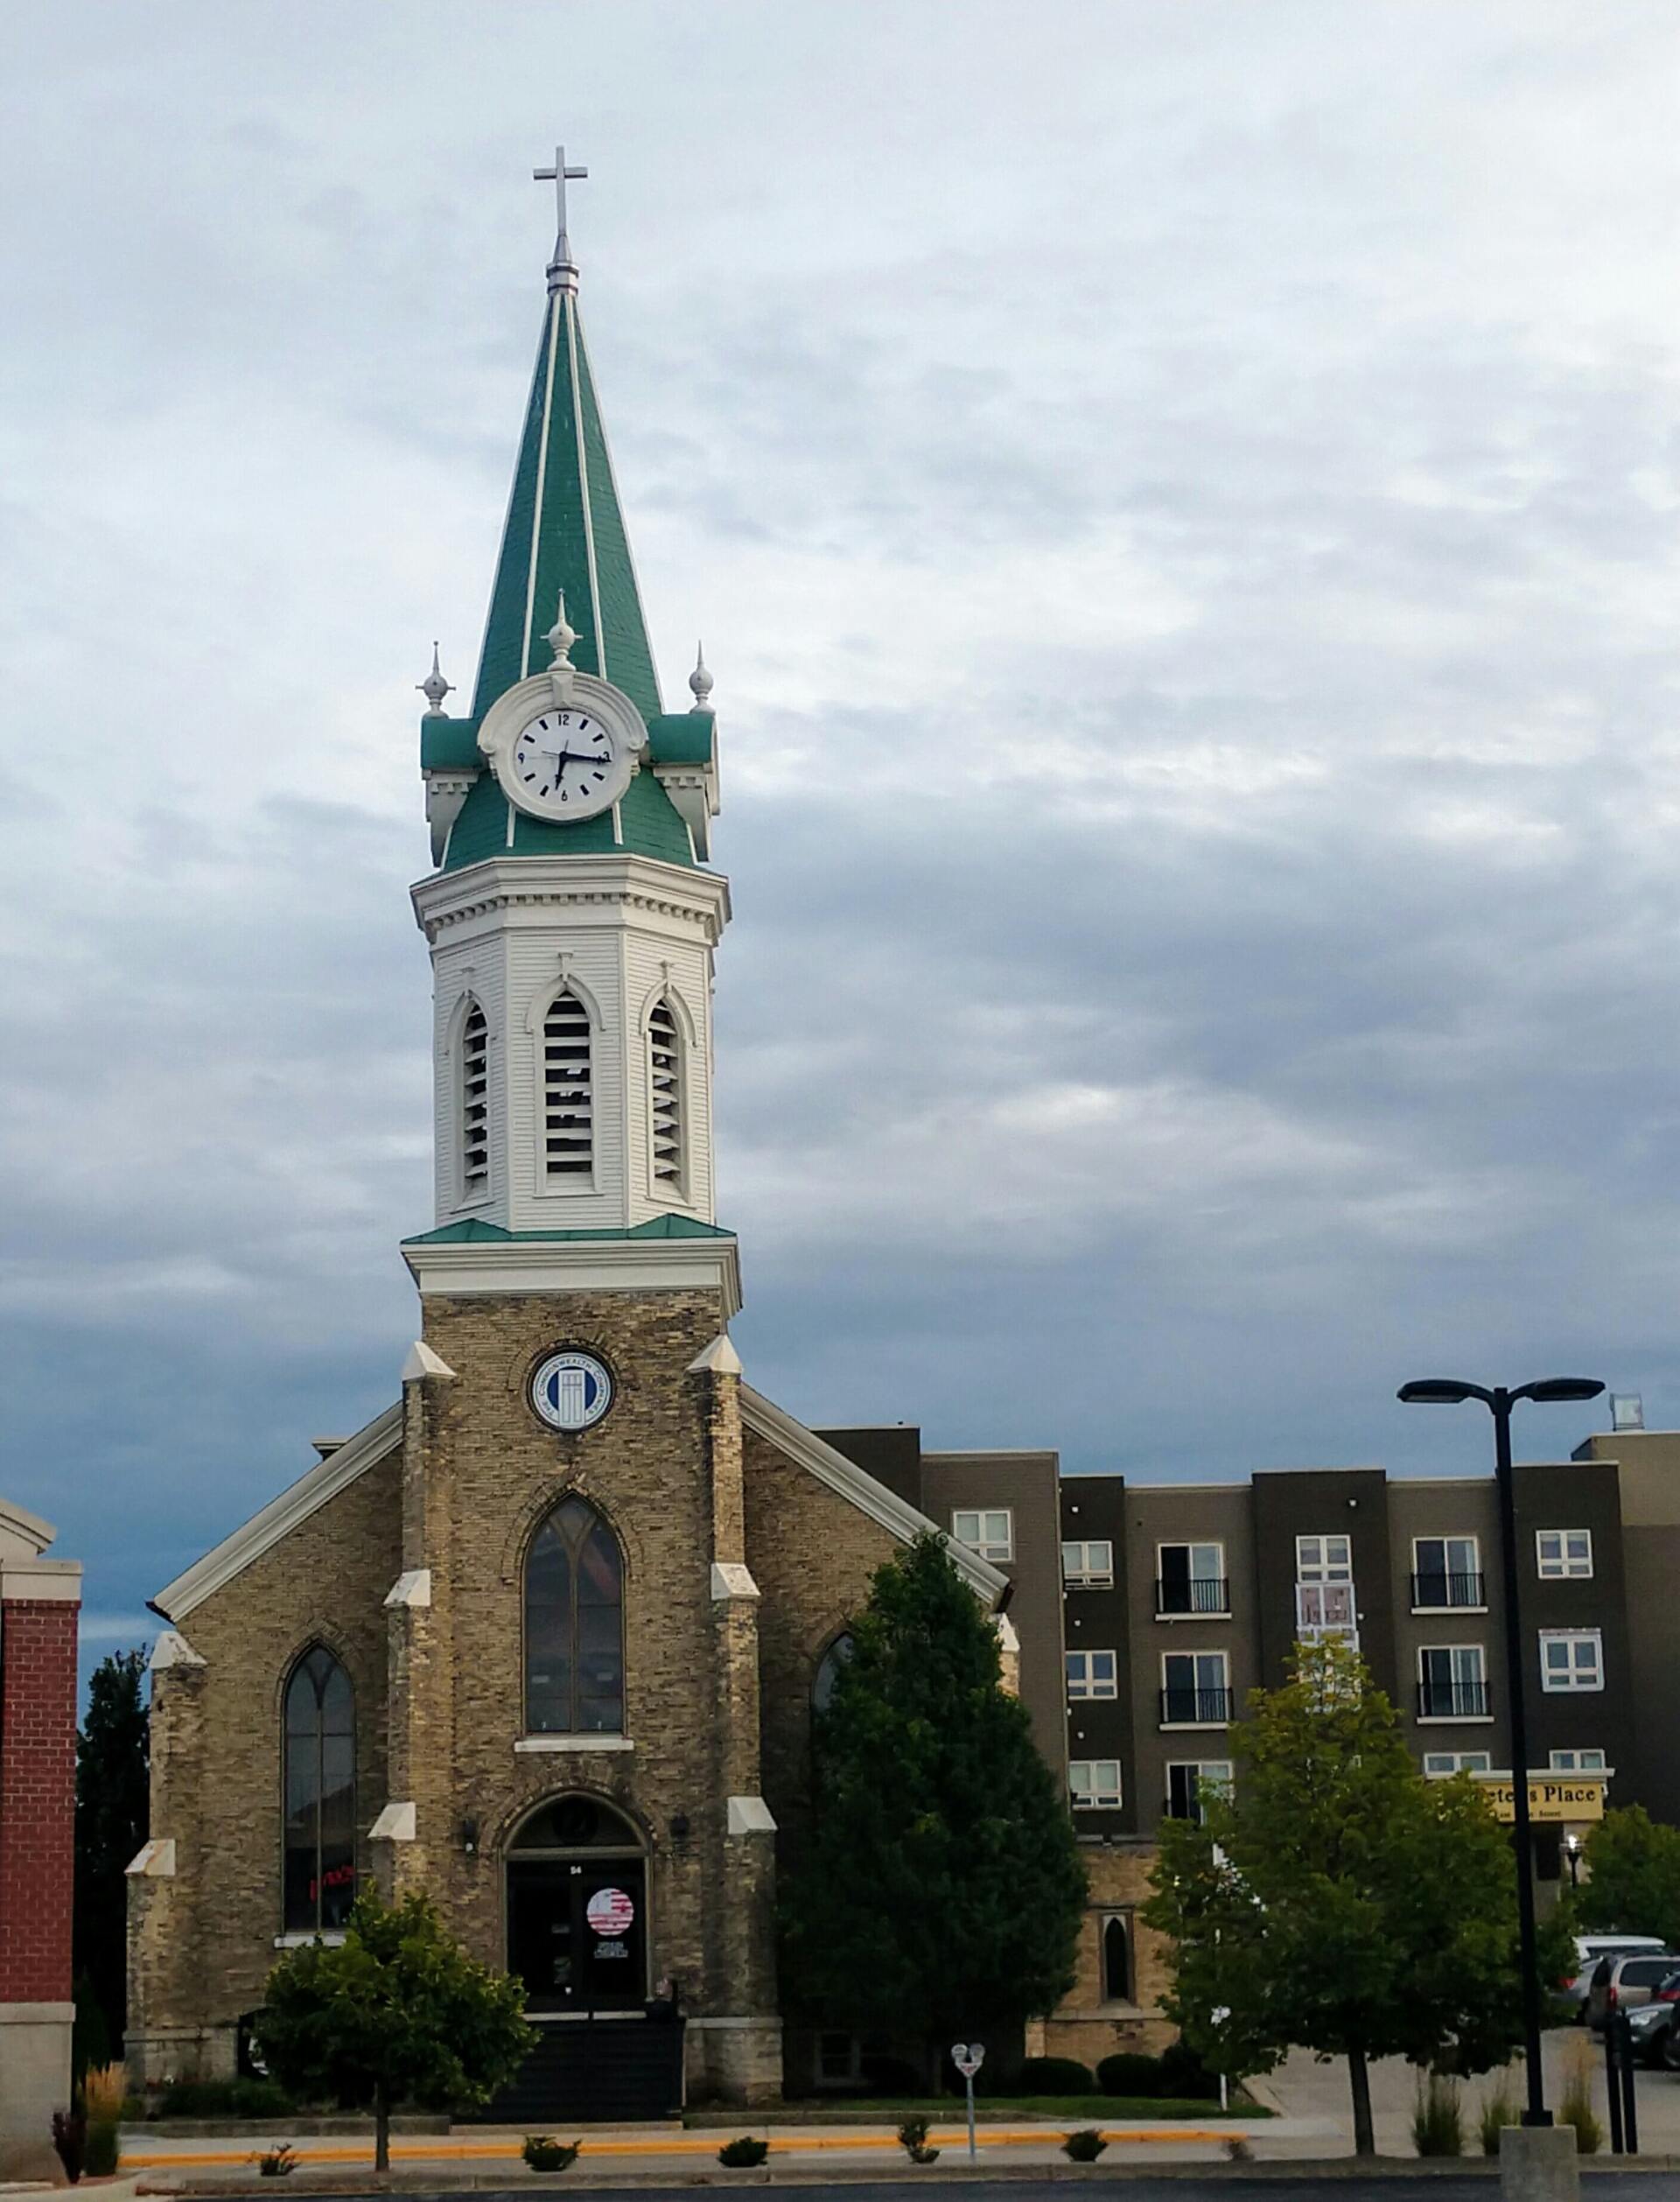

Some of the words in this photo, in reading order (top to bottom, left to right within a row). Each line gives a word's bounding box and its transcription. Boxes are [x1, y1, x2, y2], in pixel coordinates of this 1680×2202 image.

[558, 713, 570, 726] 12
[518, 753, 525, 764] 9
[561, 789, 568, 802] 6
[1544, 1785, 1596, 1802] Place
